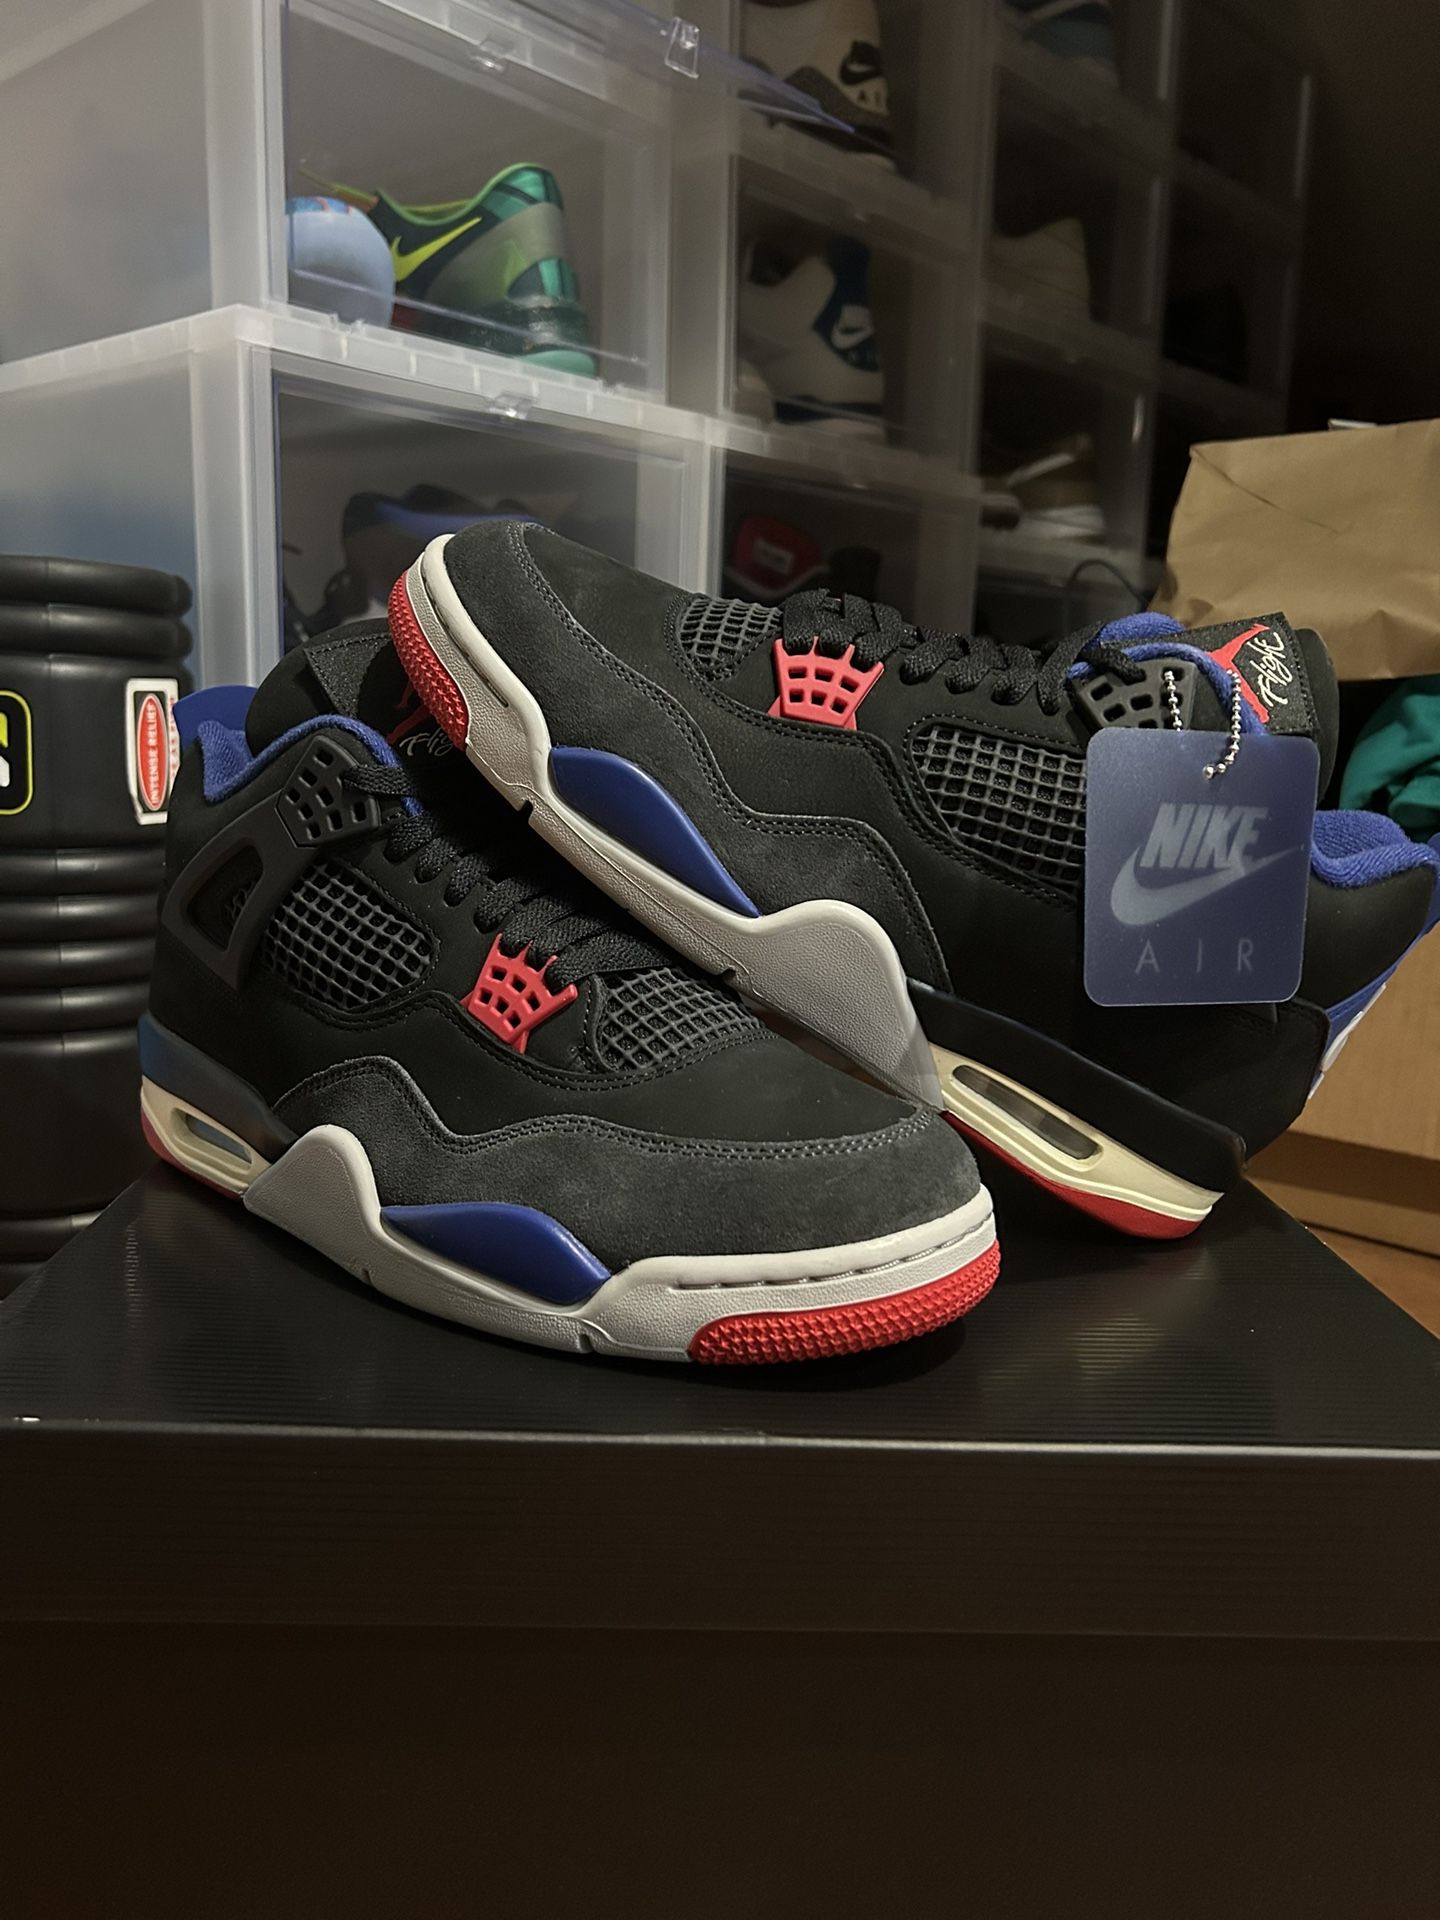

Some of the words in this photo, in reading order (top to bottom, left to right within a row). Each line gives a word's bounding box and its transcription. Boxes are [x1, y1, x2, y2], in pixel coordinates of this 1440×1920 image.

[1246, 631, 1294, 708] Flight
[1140, 802, 1270, 871] NIKE
[1134, 938, 1255, 975] AIR
